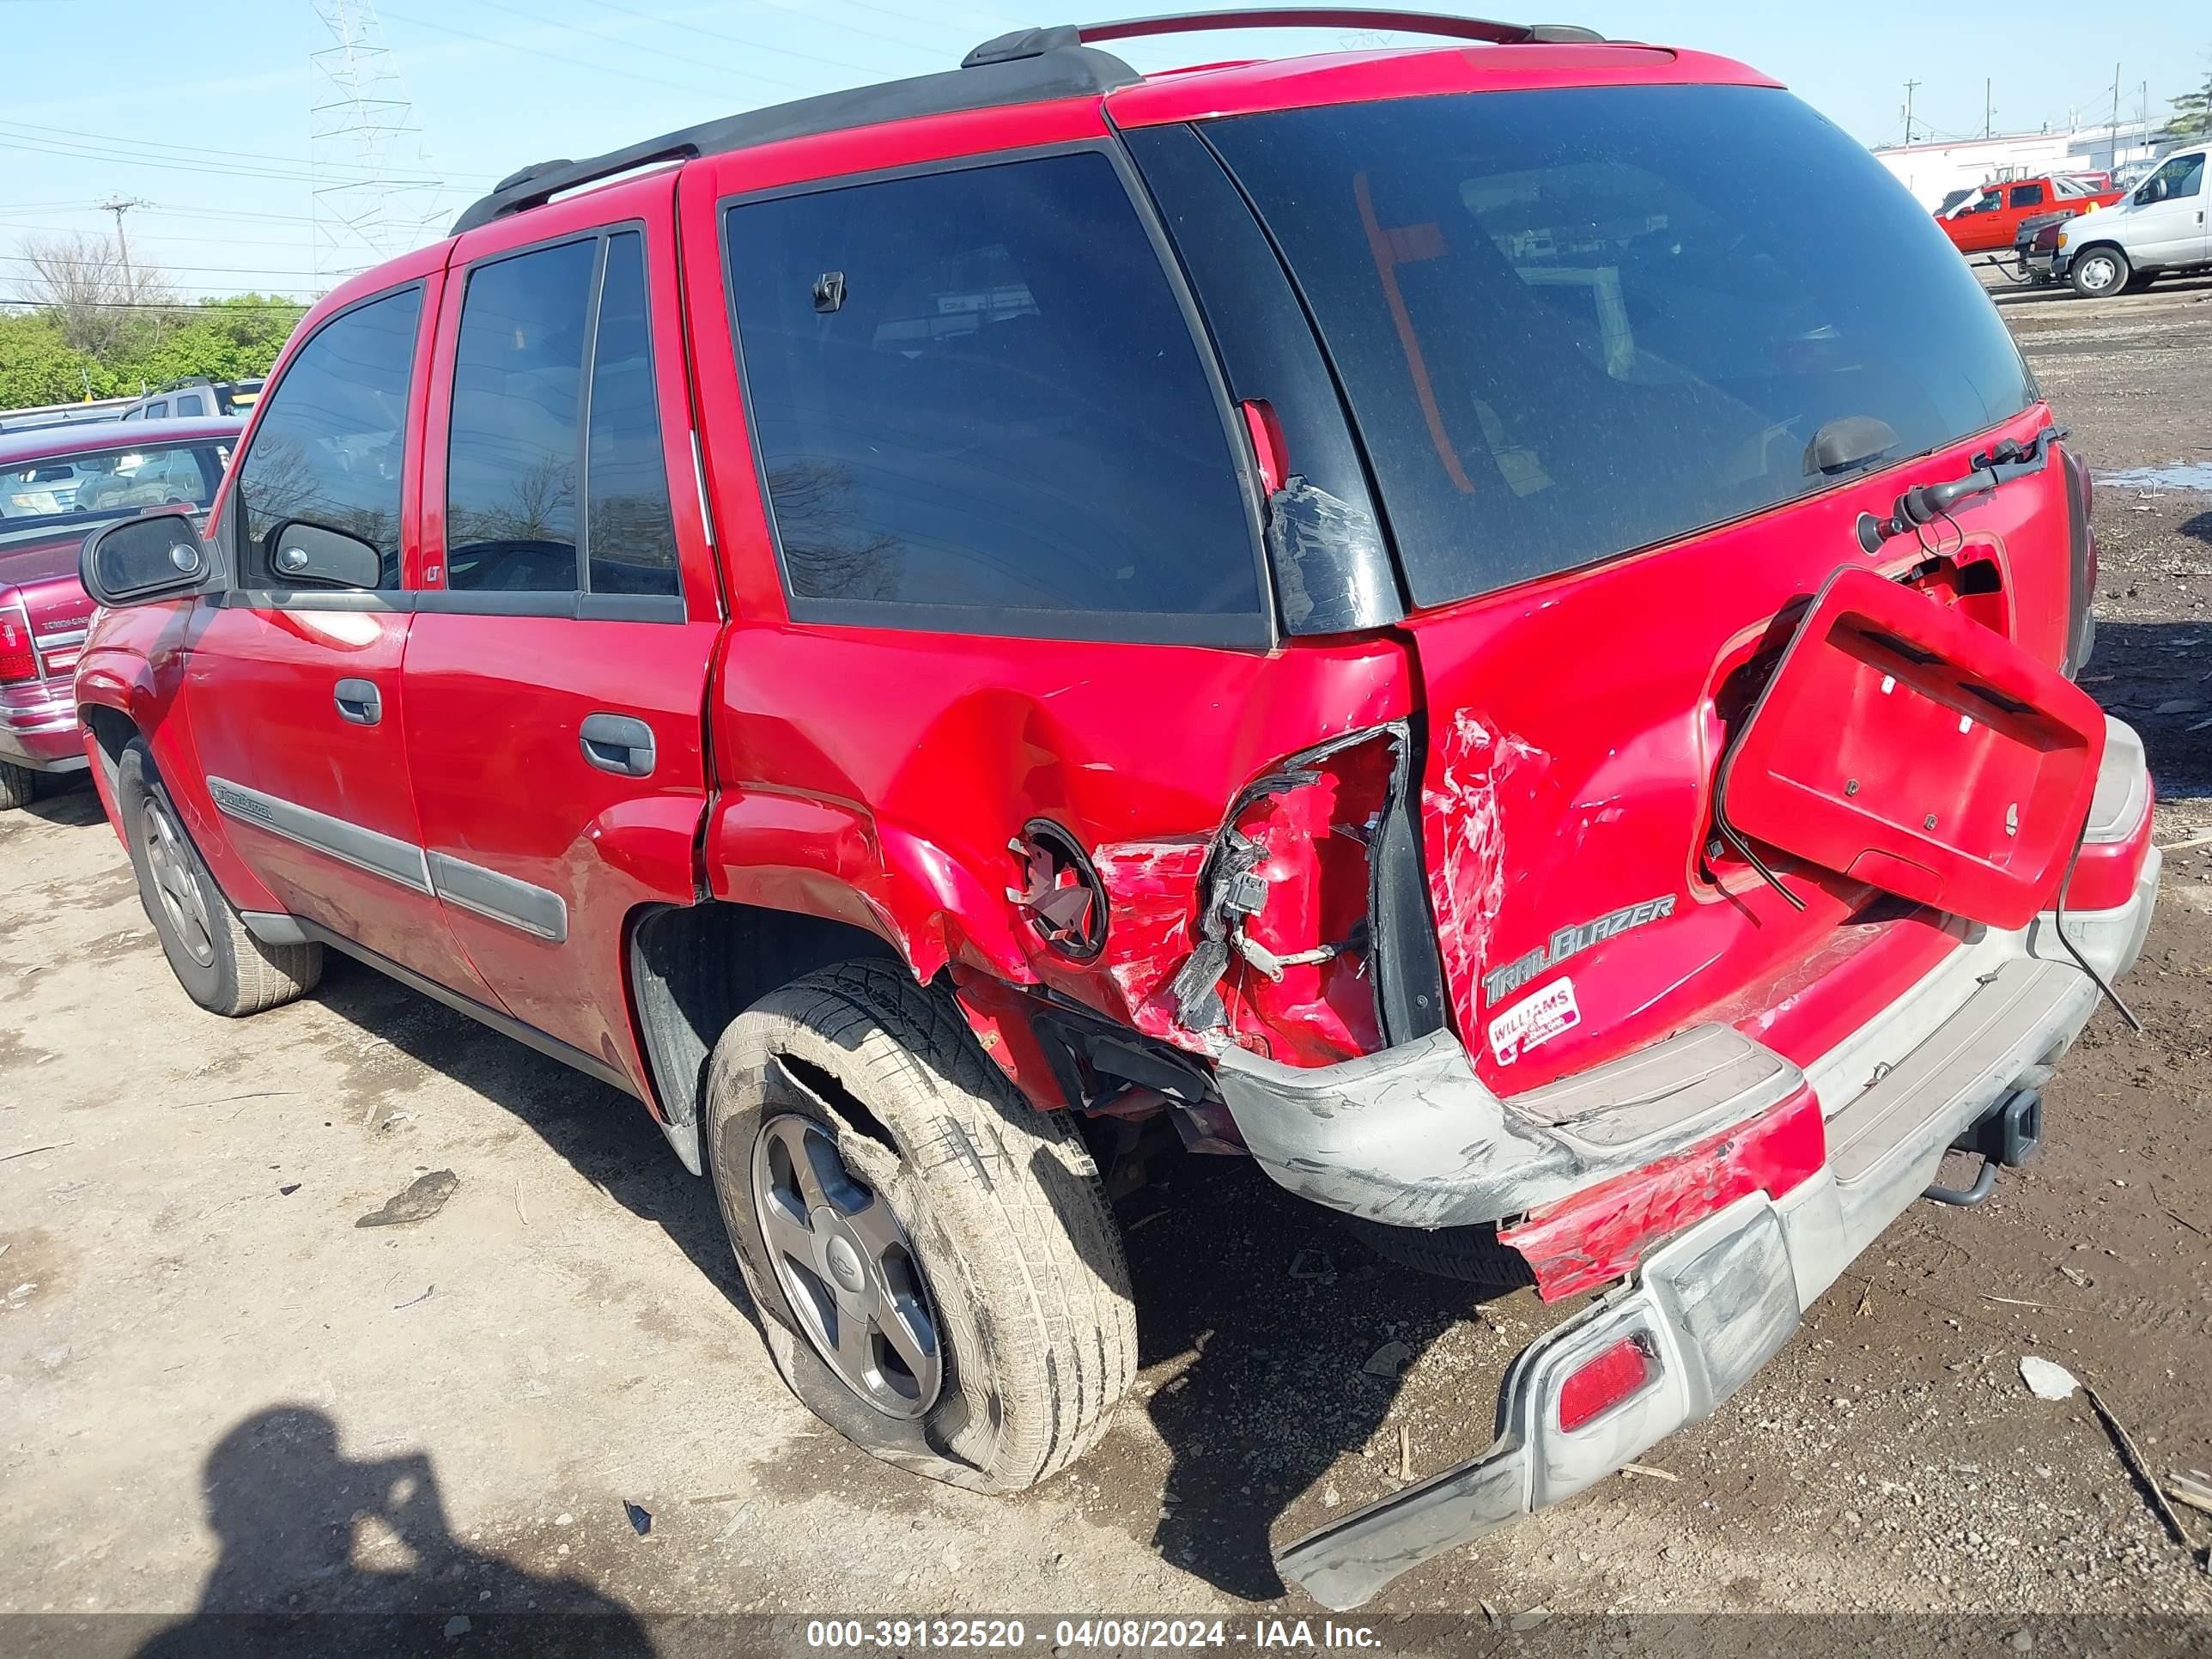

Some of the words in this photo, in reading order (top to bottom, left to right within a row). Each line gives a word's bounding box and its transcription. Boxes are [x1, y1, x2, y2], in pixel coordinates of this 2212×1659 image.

[427, 565, 440, 582] LT
[1481, 893, 1677, 1009] TRAILBLAZER
[1494, 989, 1569, 1042] WILLIAMS
